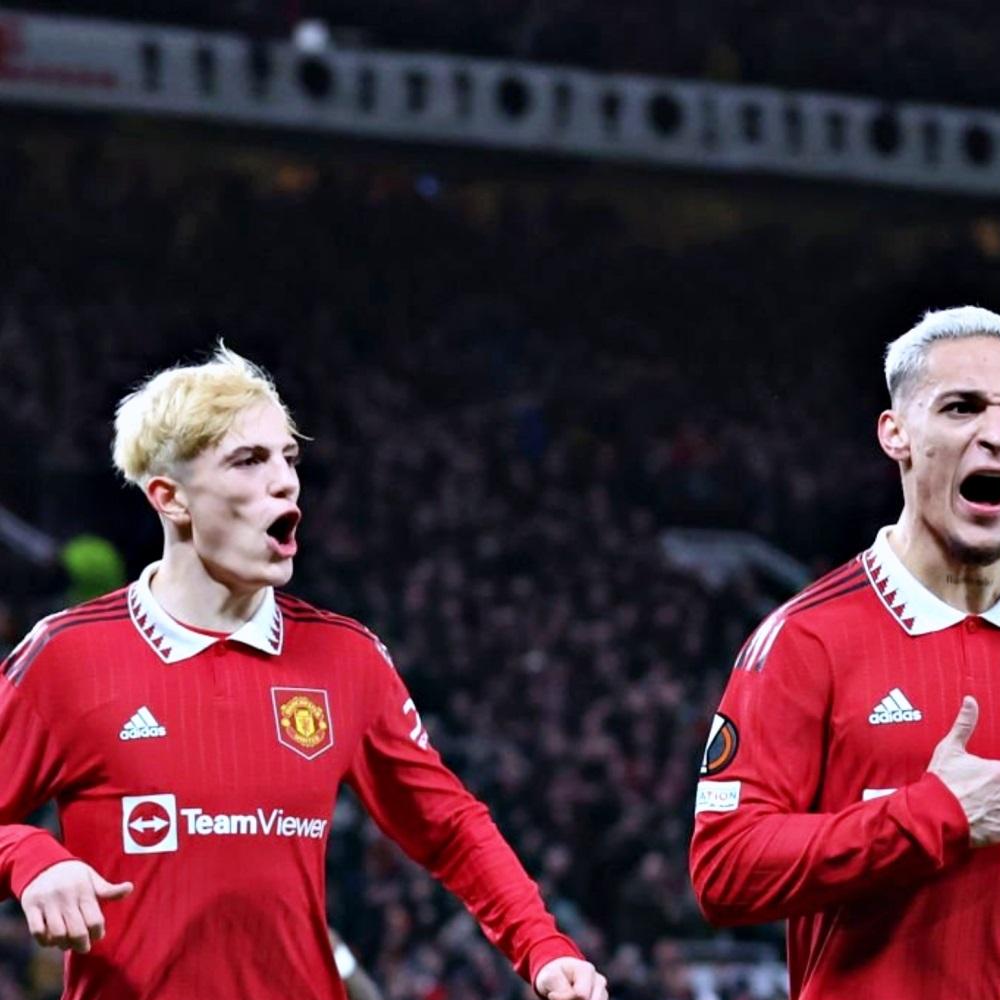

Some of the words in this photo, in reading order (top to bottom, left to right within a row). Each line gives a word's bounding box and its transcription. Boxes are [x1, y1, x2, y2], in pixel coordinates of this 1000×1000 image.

[869, 709, 922, 724] adidas
[119, 726, 167, 740] adidas
[180, 808, 328, 838] TeamViewer
